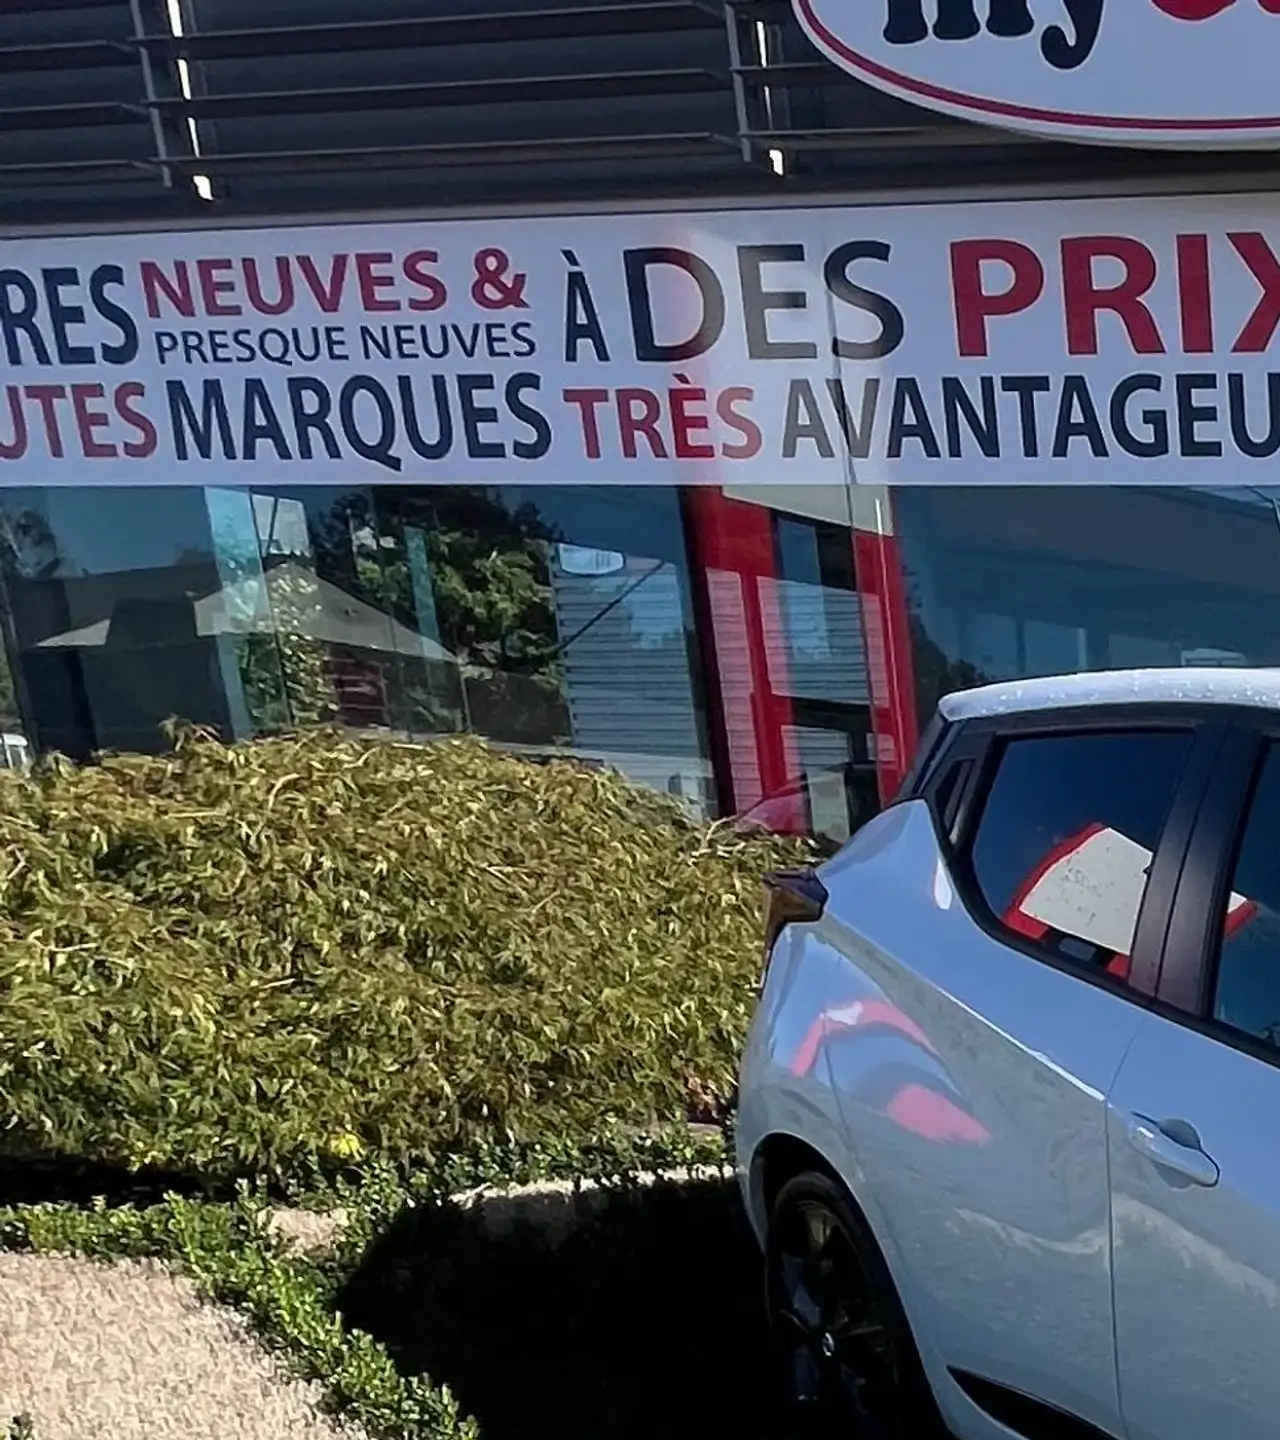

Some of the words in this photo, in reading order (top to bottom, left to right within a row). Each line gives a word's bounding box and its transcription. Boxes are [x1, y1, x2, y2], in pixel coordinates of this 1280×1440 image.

[140, 250, 446, 318] NEUVES
[471, 247, 530, 311] &
[561, 249, 610, 362] À
[624, 240, 905, 362] DES
[155, 328, 349, 366] PRESQUE
[361, 322, 536, 360] NEUVES
[166, 372, 552, 472] MARQUES
[563, 373, 763, 459] TRÈS
